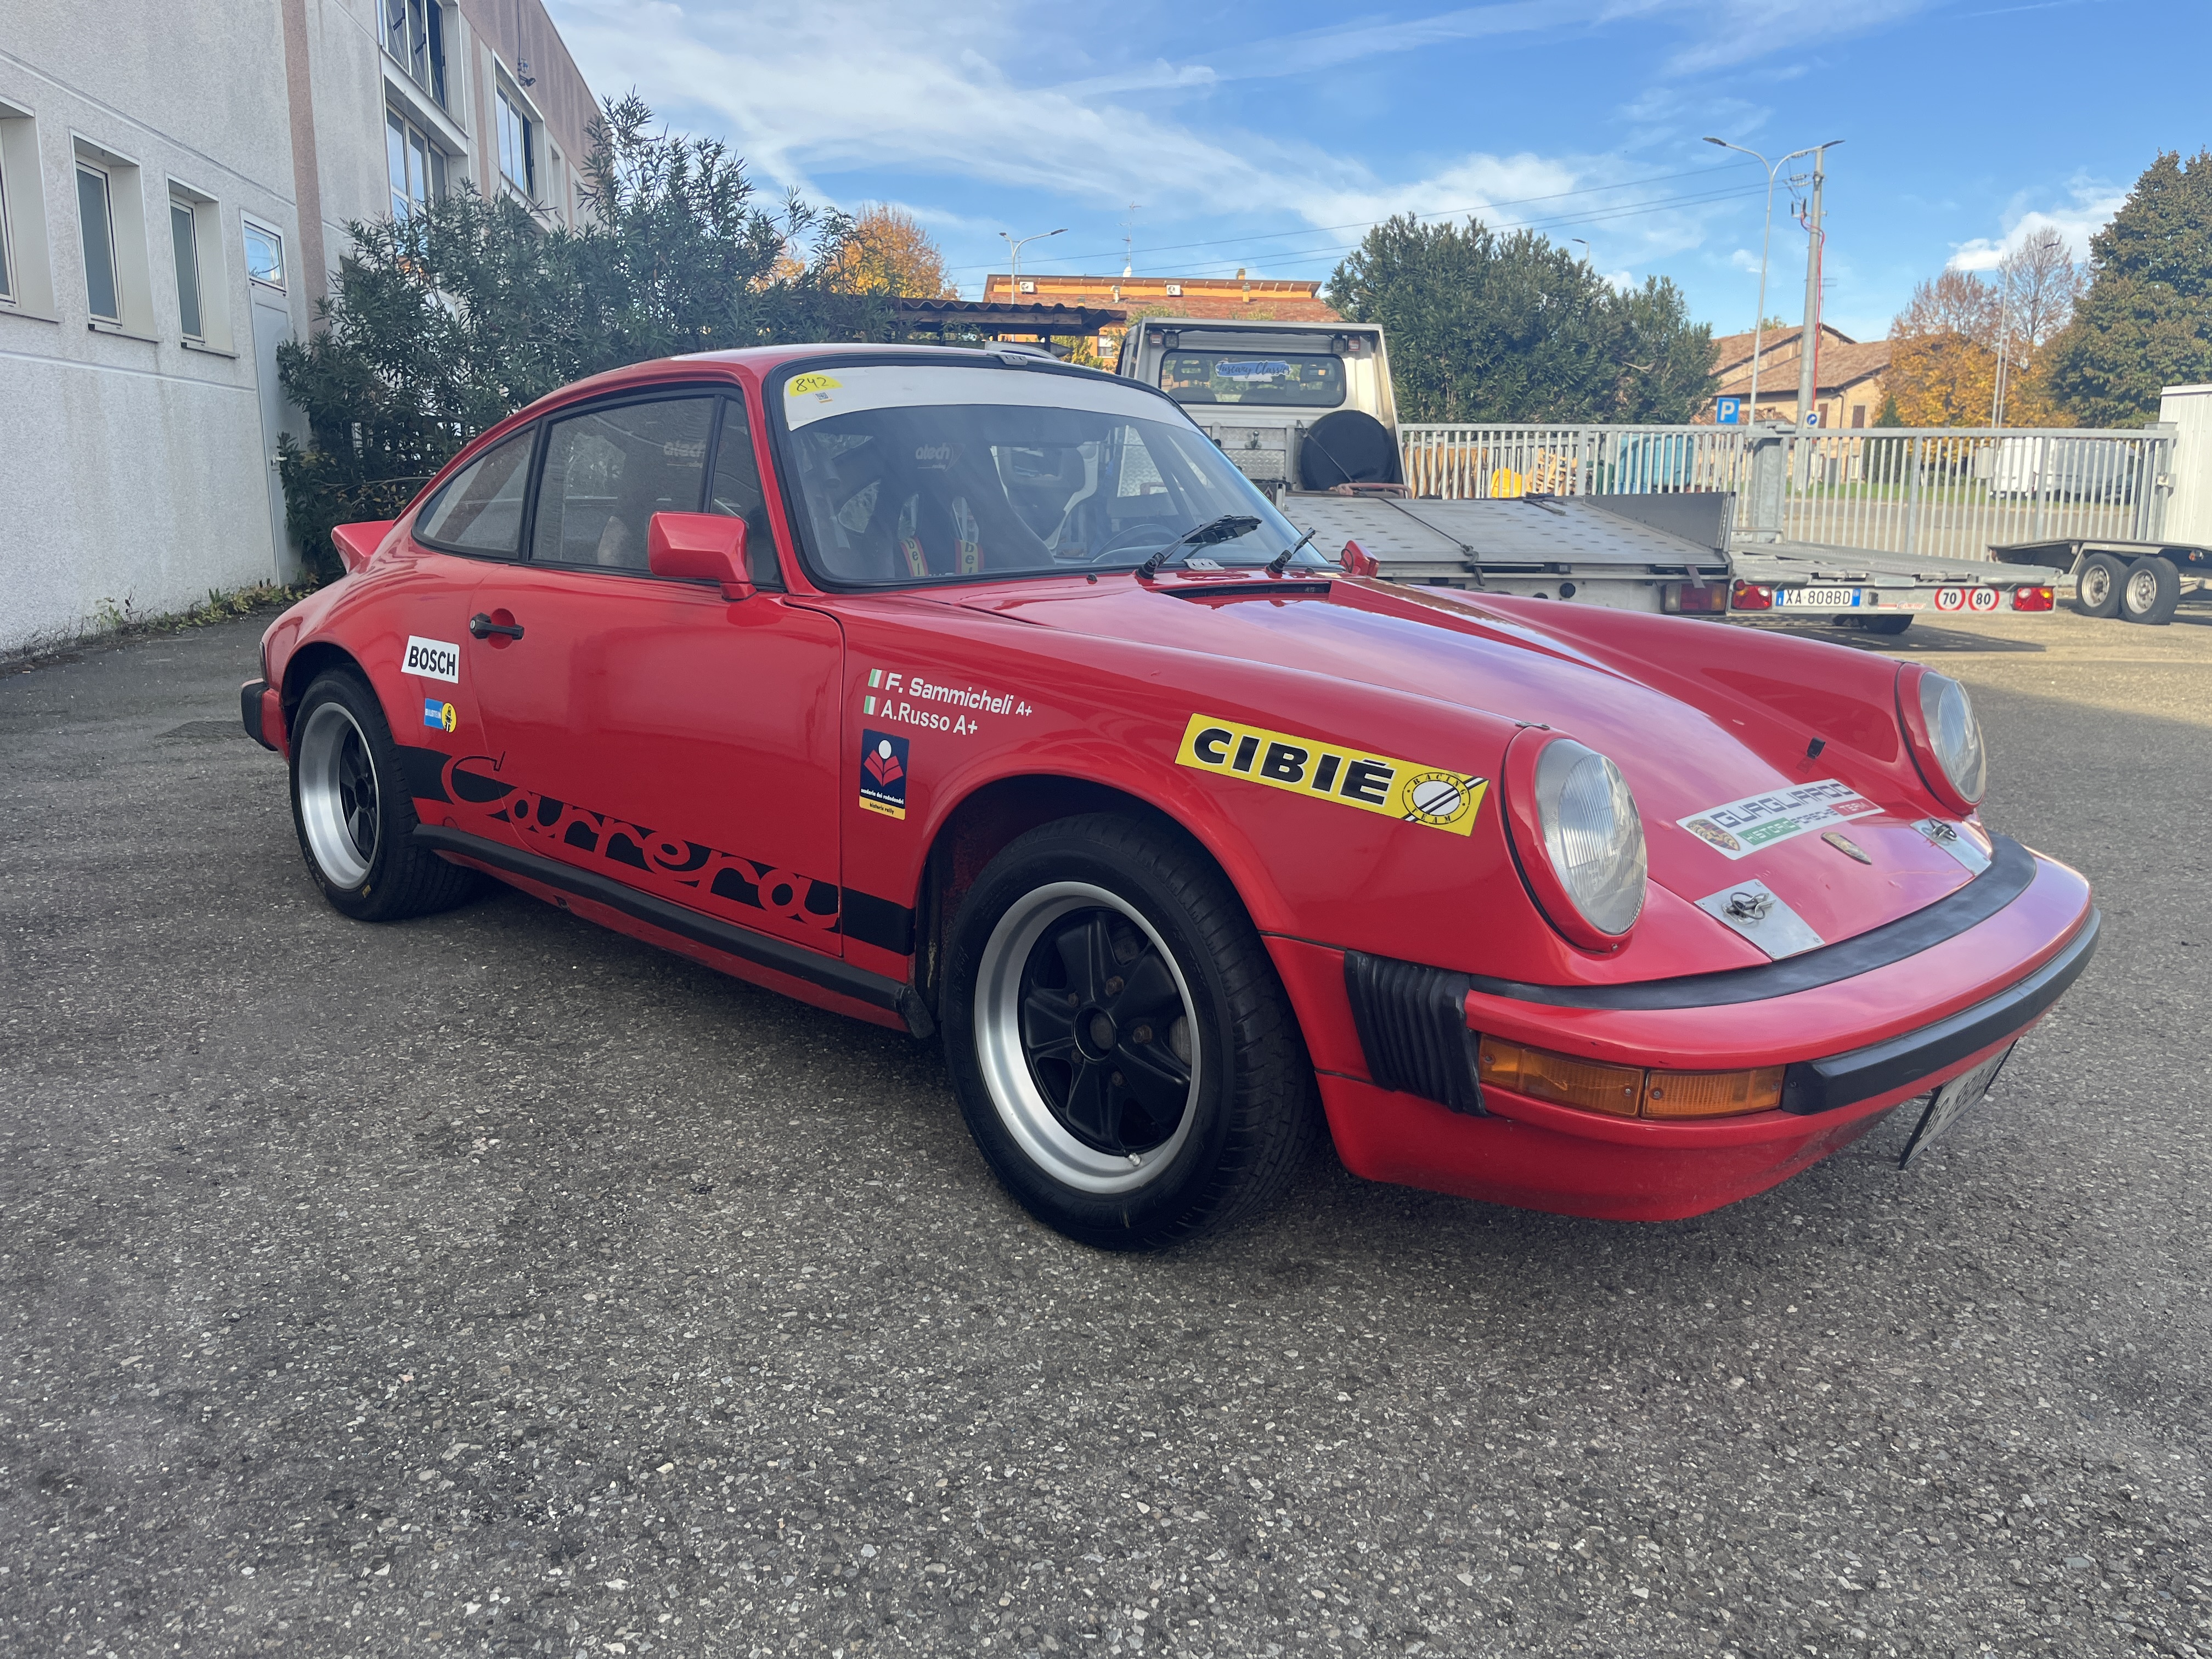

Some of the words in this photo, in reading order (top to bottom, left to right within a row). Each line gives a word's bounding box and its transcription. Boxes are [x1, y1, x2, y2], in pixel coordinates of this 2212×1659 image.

[1255, 362, 1291, 375] Classics
[796, 377, 829, 392] 842
[1720, 402, 1735, 421] P
[916, 442, 950, 460] atech
[1786, 590, 1802, 604] XA
[1808, 591, 1850, 604] 808BD
[1943, 592, 1957, 605] 70
[1976, 592, 1991, 605] 80
[408, 646, 455, 676] BOSCH
[885, 673, 904, 693] F.
[909, 677, 1014, 714] Sammicheli
[1015, 701, 1032, 716] A+
[425, 708, 441, 719] BILSTEIN
[881, 699, 950, 731] A.Russo
[952, 714, 978, 735] A+
[1413, 774, 1466, 795] RACING
[870, 802, 884, 811] historic
[1710, 783, 1855, 828] GUAGLIARDO
[1412, 807, 1451, 823] TEAM
[1742, 820, 1796, 845] HISTORIC
[1790, 808, 1839, 824] PORSCHE
[1838, 802, 1870, 812] TEAM
[441, 751, 840, 928] Carrera
